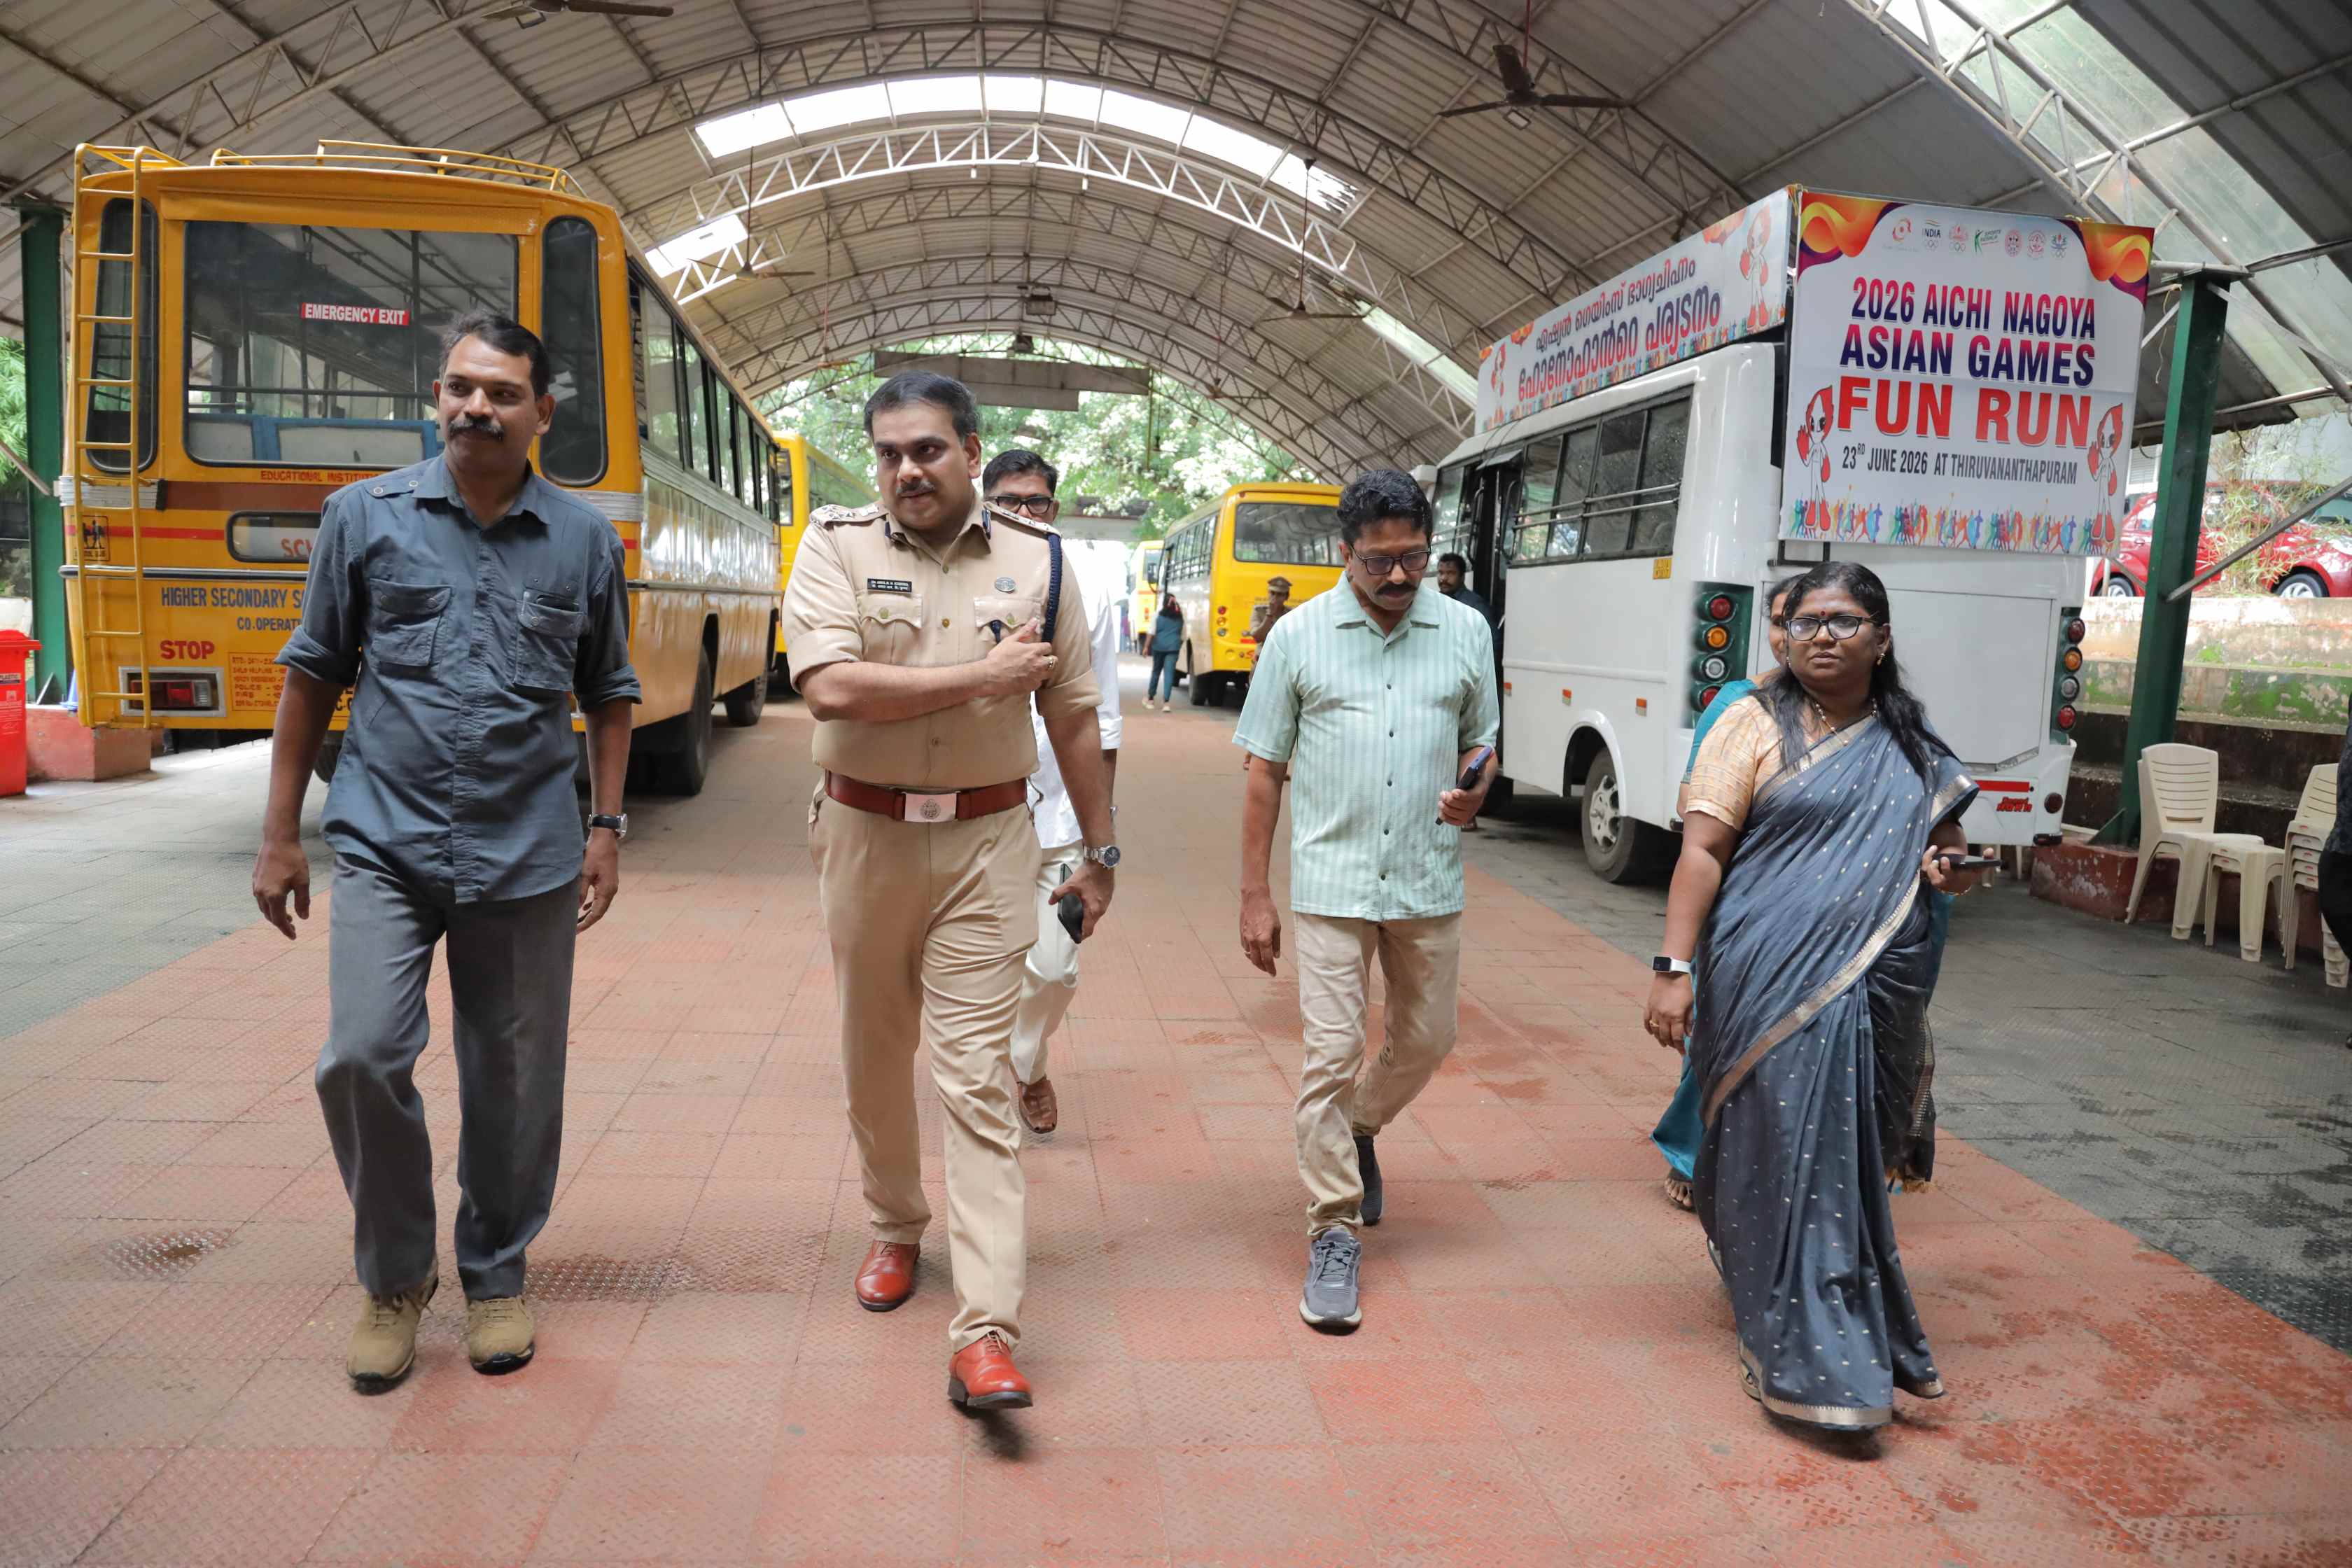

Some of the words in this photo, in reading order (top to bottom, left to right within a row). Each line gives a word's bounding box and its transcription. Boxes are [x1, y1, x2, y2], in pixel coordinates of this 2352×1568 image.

[1922, 228, 1941, 239] INDIA
[305, 303, 376, 323] EMERGENCY
[379, 309, 405, 325] EXIT
[1851, 276, 1915, 324] 2026
[1922, 284, 1991, 330] AICHI
[2003, 291, 2095, 341] NAGOYA
[1840, 323, 1954, 376] ASIAN
[1968, 335, 2095, 388] GAMES
[1837, 376, 1953, 440] FUN
[1975, 387, 2092, 449] RUN
[260, 470, 323, 482] EDUCATIONAL
[1867, 447, 1897, 472] JUNE
[1900, 451, 1928, 475] 2026
[1934, 453, 1948, 477] AT
[1951, 454, 2078, 484] THIRUVANANTHAPURAM
[161, 587, 206, 607] HIGHER
[211, 588, 288, 608] SECONDARY
[293, 589, 304, 608] S
[160, 640, 215, 659] STOP
